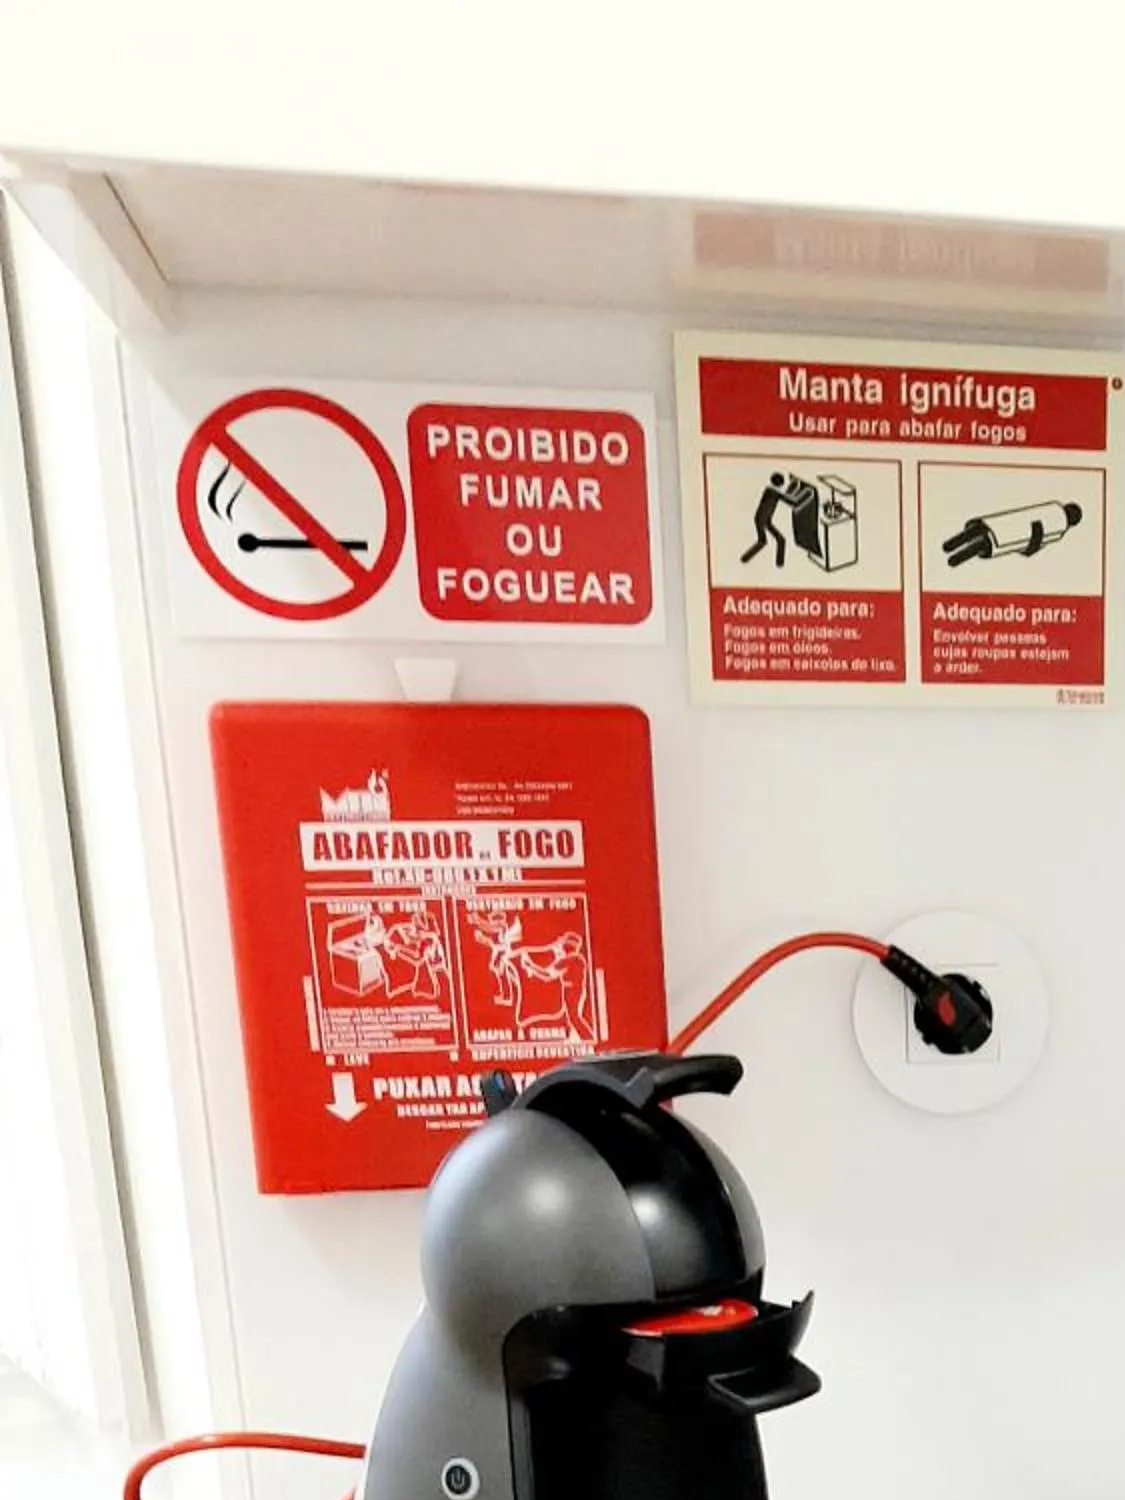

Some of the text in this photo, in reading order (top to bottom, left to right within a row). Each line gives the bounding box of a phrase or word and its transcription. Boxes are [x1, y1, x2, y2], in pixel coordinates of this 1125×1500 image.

[778, 367, 1035, 417] Manta ignífuga
[427, 423, 629, 464] PROIBIDO
[789, 412, 1027, 444] Usar para abafar fogos
[460, 474, 601, 511] FUMAR
[507, 524, 562, 557] OU
[437, 567, 635, 604] FOGUEAR
[724, 596, 875, 620] Adequado para:
[933, 602, 1077, 626] Adequado para:
[724, 623, 766, 640] Fogos
[769, 626, 790, 638] em
[725, 639, 766, 656] Fogos
[769, 642, 790, 654] em
[725, 655, 767, 671] Fogos
[770, 658, 791, 670] em
[313, 829, 474, 861] ABAFADOR
[498, 828, 575, 859] FOGO
[373, 1075, 451, 1100] PUXAR
